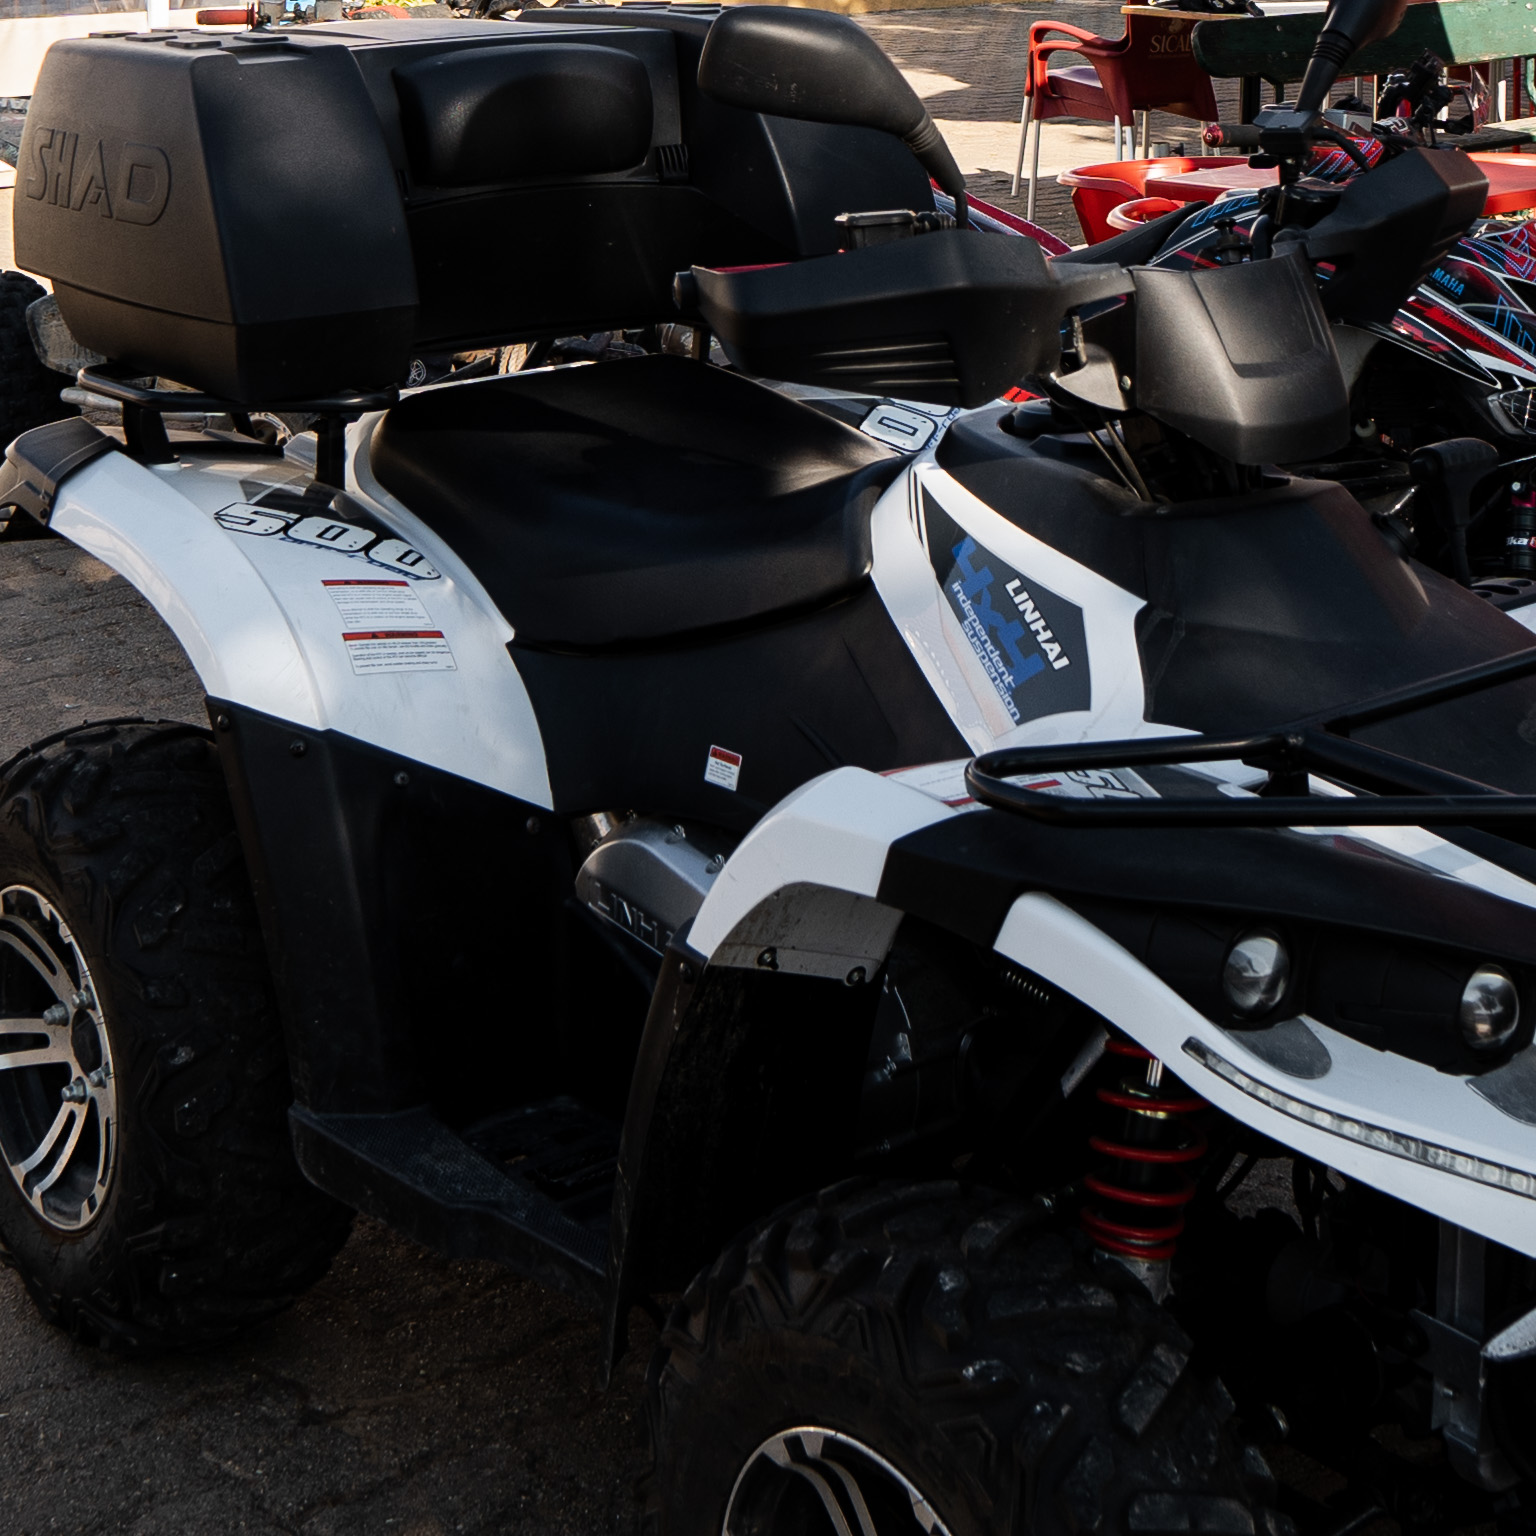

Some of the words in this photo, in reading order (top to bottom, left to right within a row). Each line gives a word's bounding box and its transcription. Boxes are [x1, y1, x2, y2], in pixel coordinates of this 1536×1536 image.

[1149, 33, 1191, 53] SICAL
[26, 126, 172, 227] SHAD
[1428, 267, 1465, 296] MAHA
[213, 501, 442, 581] 500
[951, 579, 1016, 689] independent
[961, 620, 1021, 722] suspension
[1004, 577, 1071, 671] LINHAI
